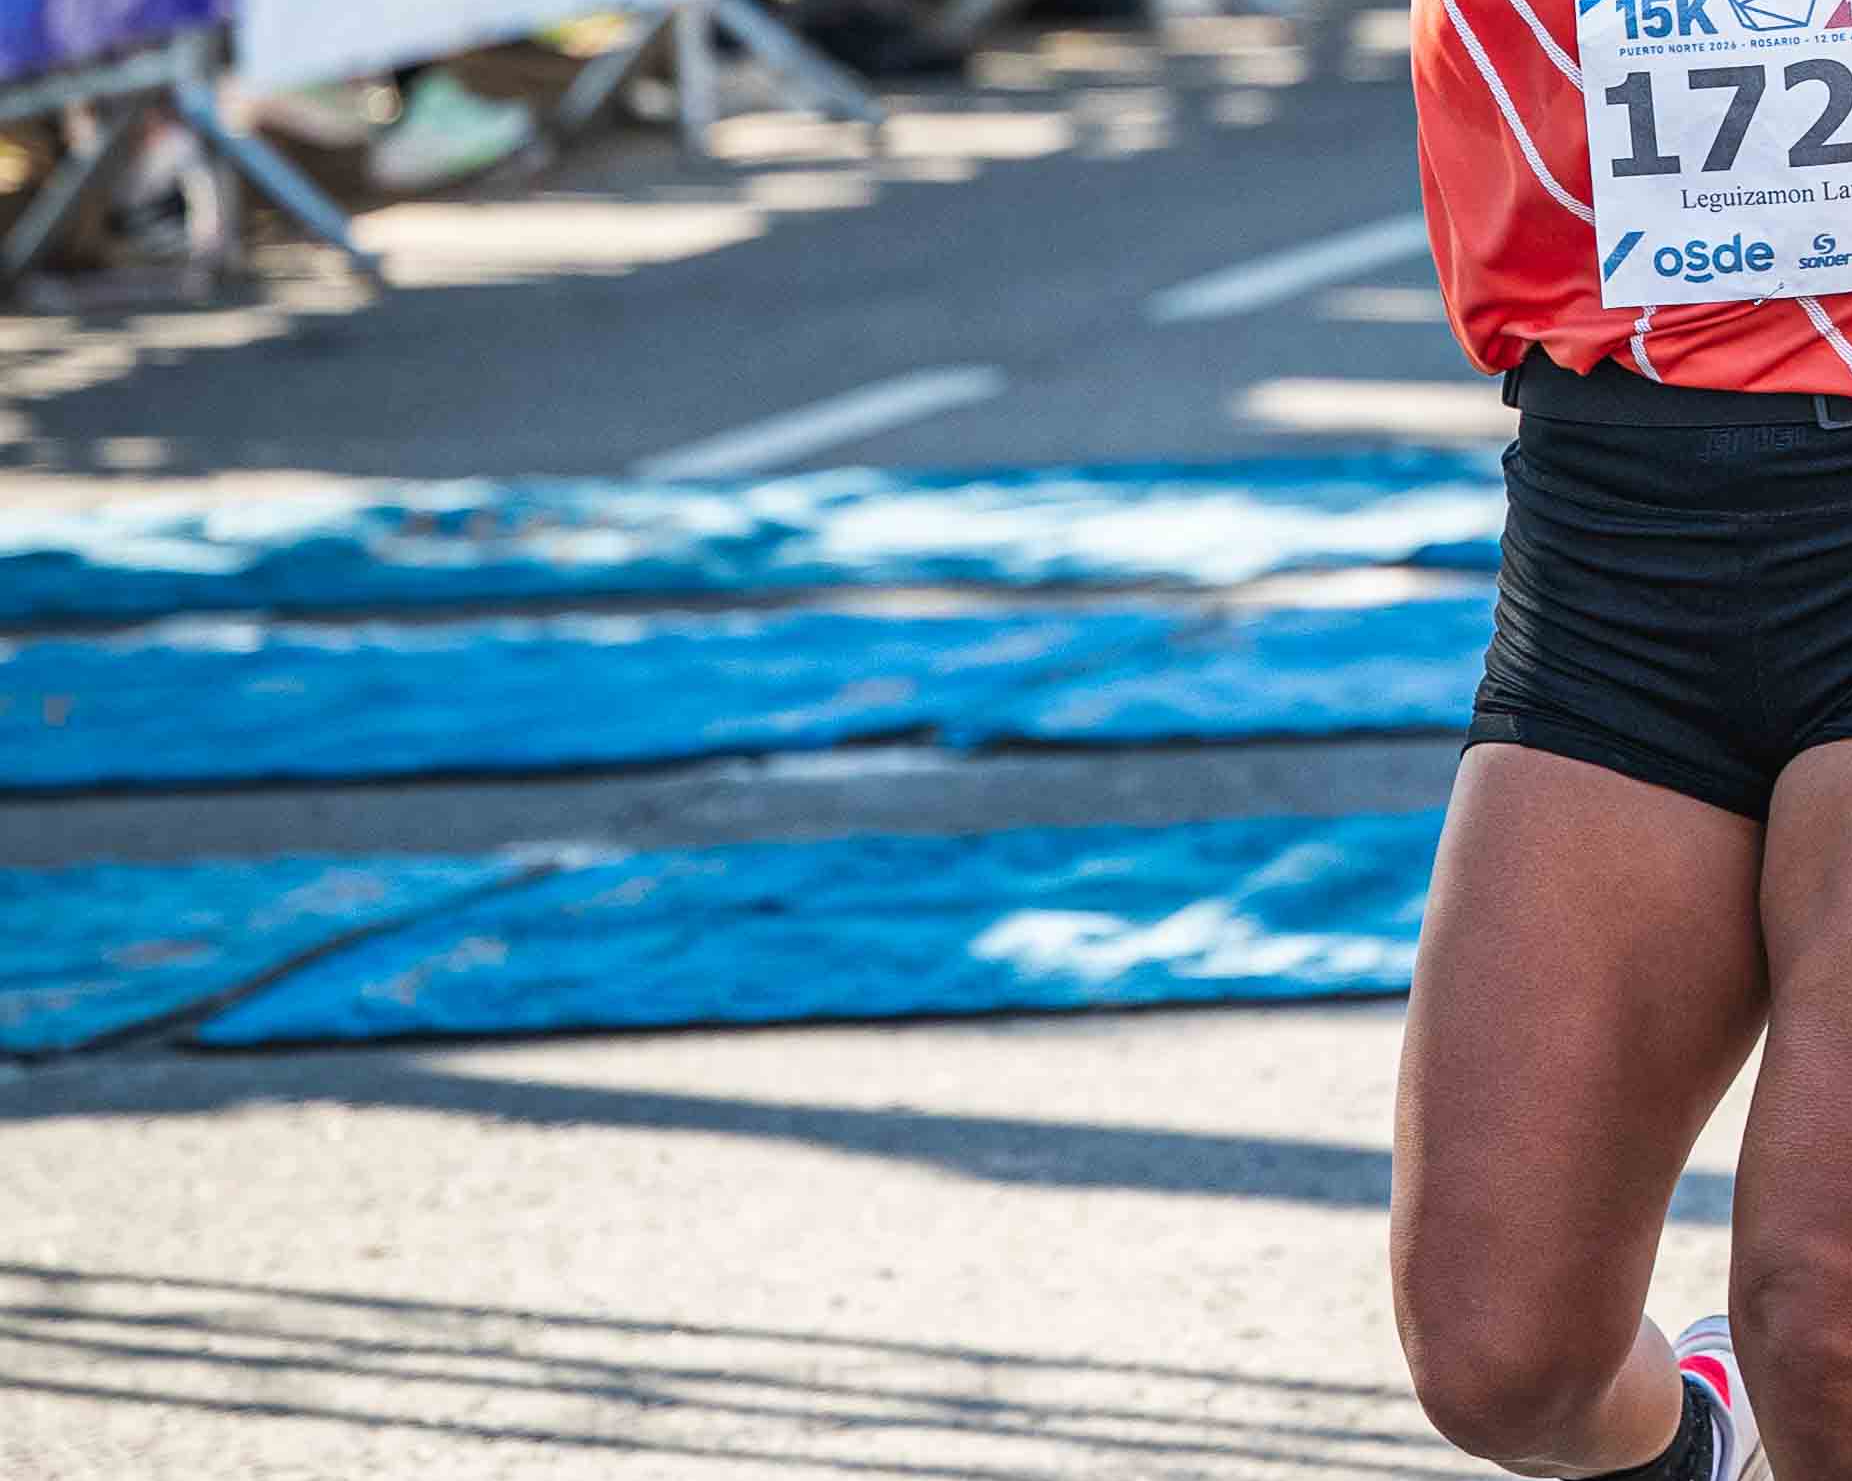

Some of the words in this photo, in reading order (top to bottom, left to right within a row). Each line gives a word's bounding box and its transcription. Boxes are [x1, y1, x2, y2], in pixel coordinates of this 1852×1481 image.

[1619, 44, 1665, 57] PUERTO
[1668, 42, 1706, 54] NORTE
[1709, 40, 1738, 52] 2026
[1750, 37, 1801, 49] ROSARIO
[1814, 35, 1829, 45] 12
[1831, 32, 1848, 43] DE
[1681, 185, 1815, 214] Leguizamon
[1653, 232, 1776, 282] osde
